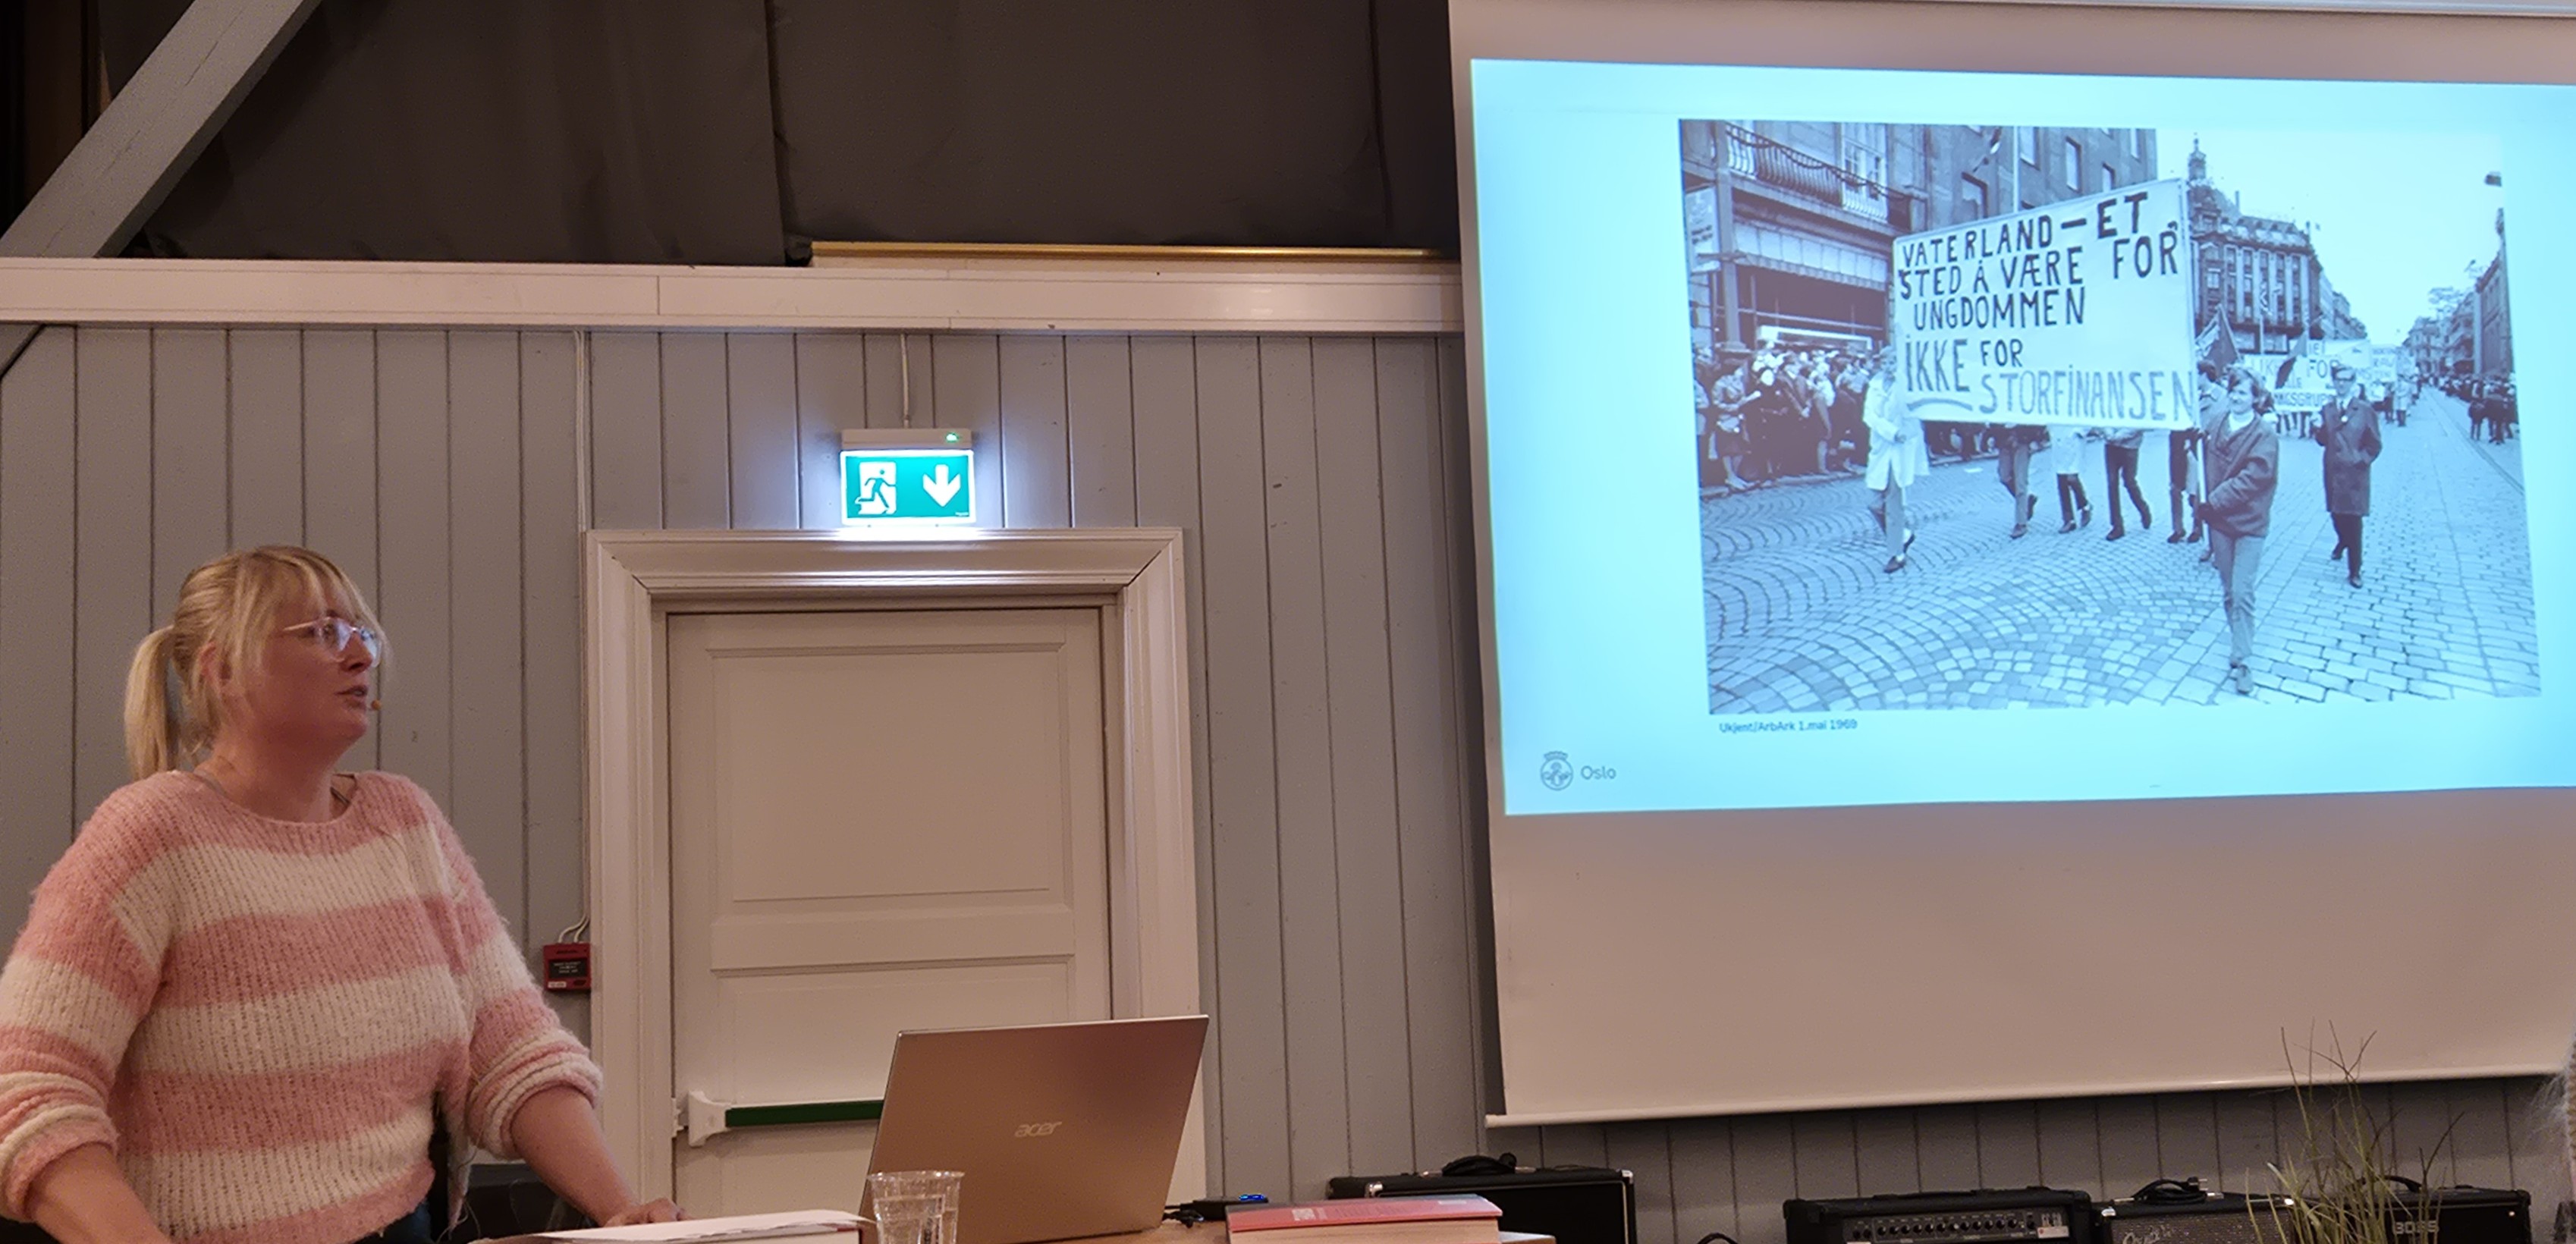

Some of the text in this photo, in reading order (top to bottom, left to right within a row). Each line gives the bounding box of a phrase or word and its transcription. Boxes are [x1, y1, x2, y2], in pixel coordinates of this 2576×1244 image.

[1902, 215, 2053, 268] VATERLAND
[2097, 191, 2148, 239] ET
[1899, 231, 2179, 300] STED Å VÆRE FOR
[1913, 287, 2085, 331] UNGDOMMEN
[1981, 338, 2023, 367] FOR
[1979, 363, 2194, 422] STORFINANSEN
[1580, 765, 1616, 781] Oslo
[1014, 1121, 1063, 1137] acer
